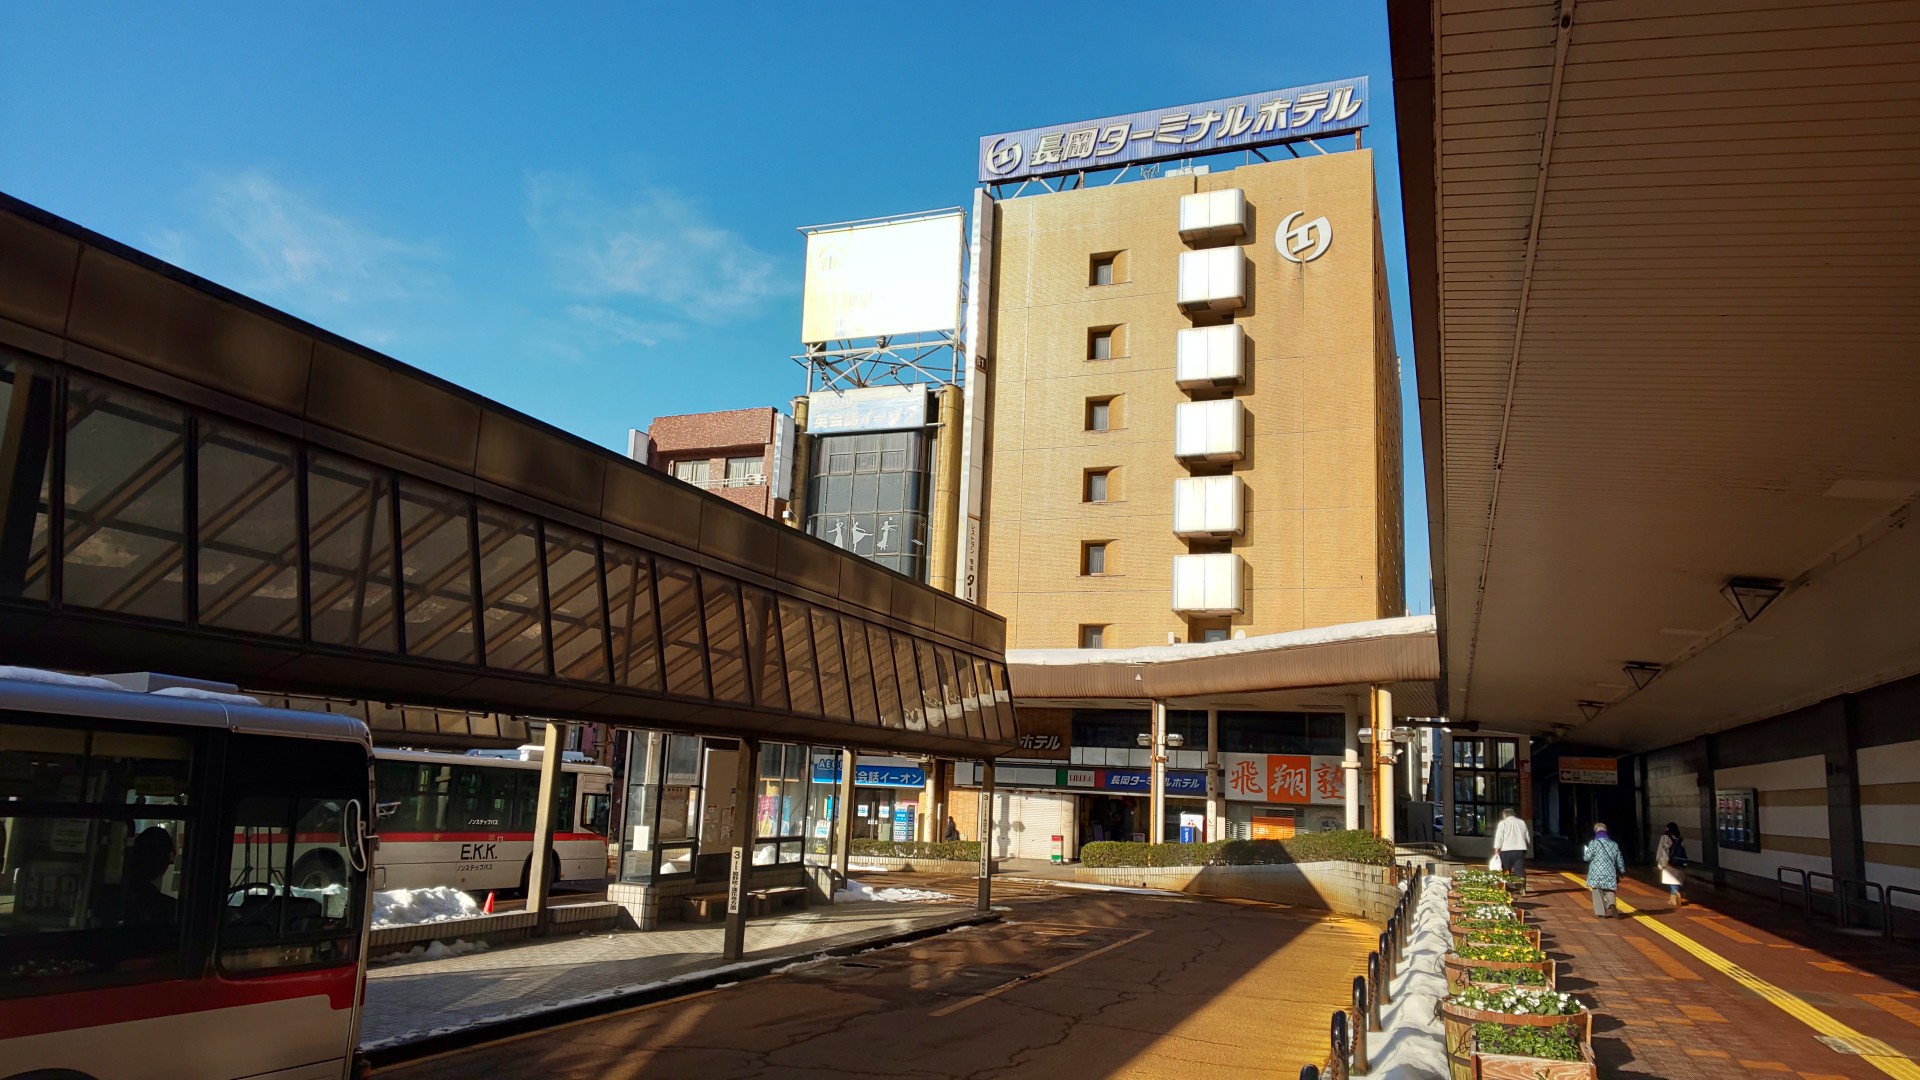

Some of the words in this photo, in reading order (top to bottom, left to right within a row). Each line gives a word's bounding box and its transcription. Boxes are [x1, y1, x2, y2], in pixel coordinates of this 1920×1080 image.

[1030, 86, 1363, 167] 長岡ターミナルホテル
[856, 771, 922, 785] 会話イーオン
[1229, 760, 1345, 800] 飛翔塾
[460, 843, 498, 861] E.K.K.
[456, 864, 493, 872] ノンステップバス
